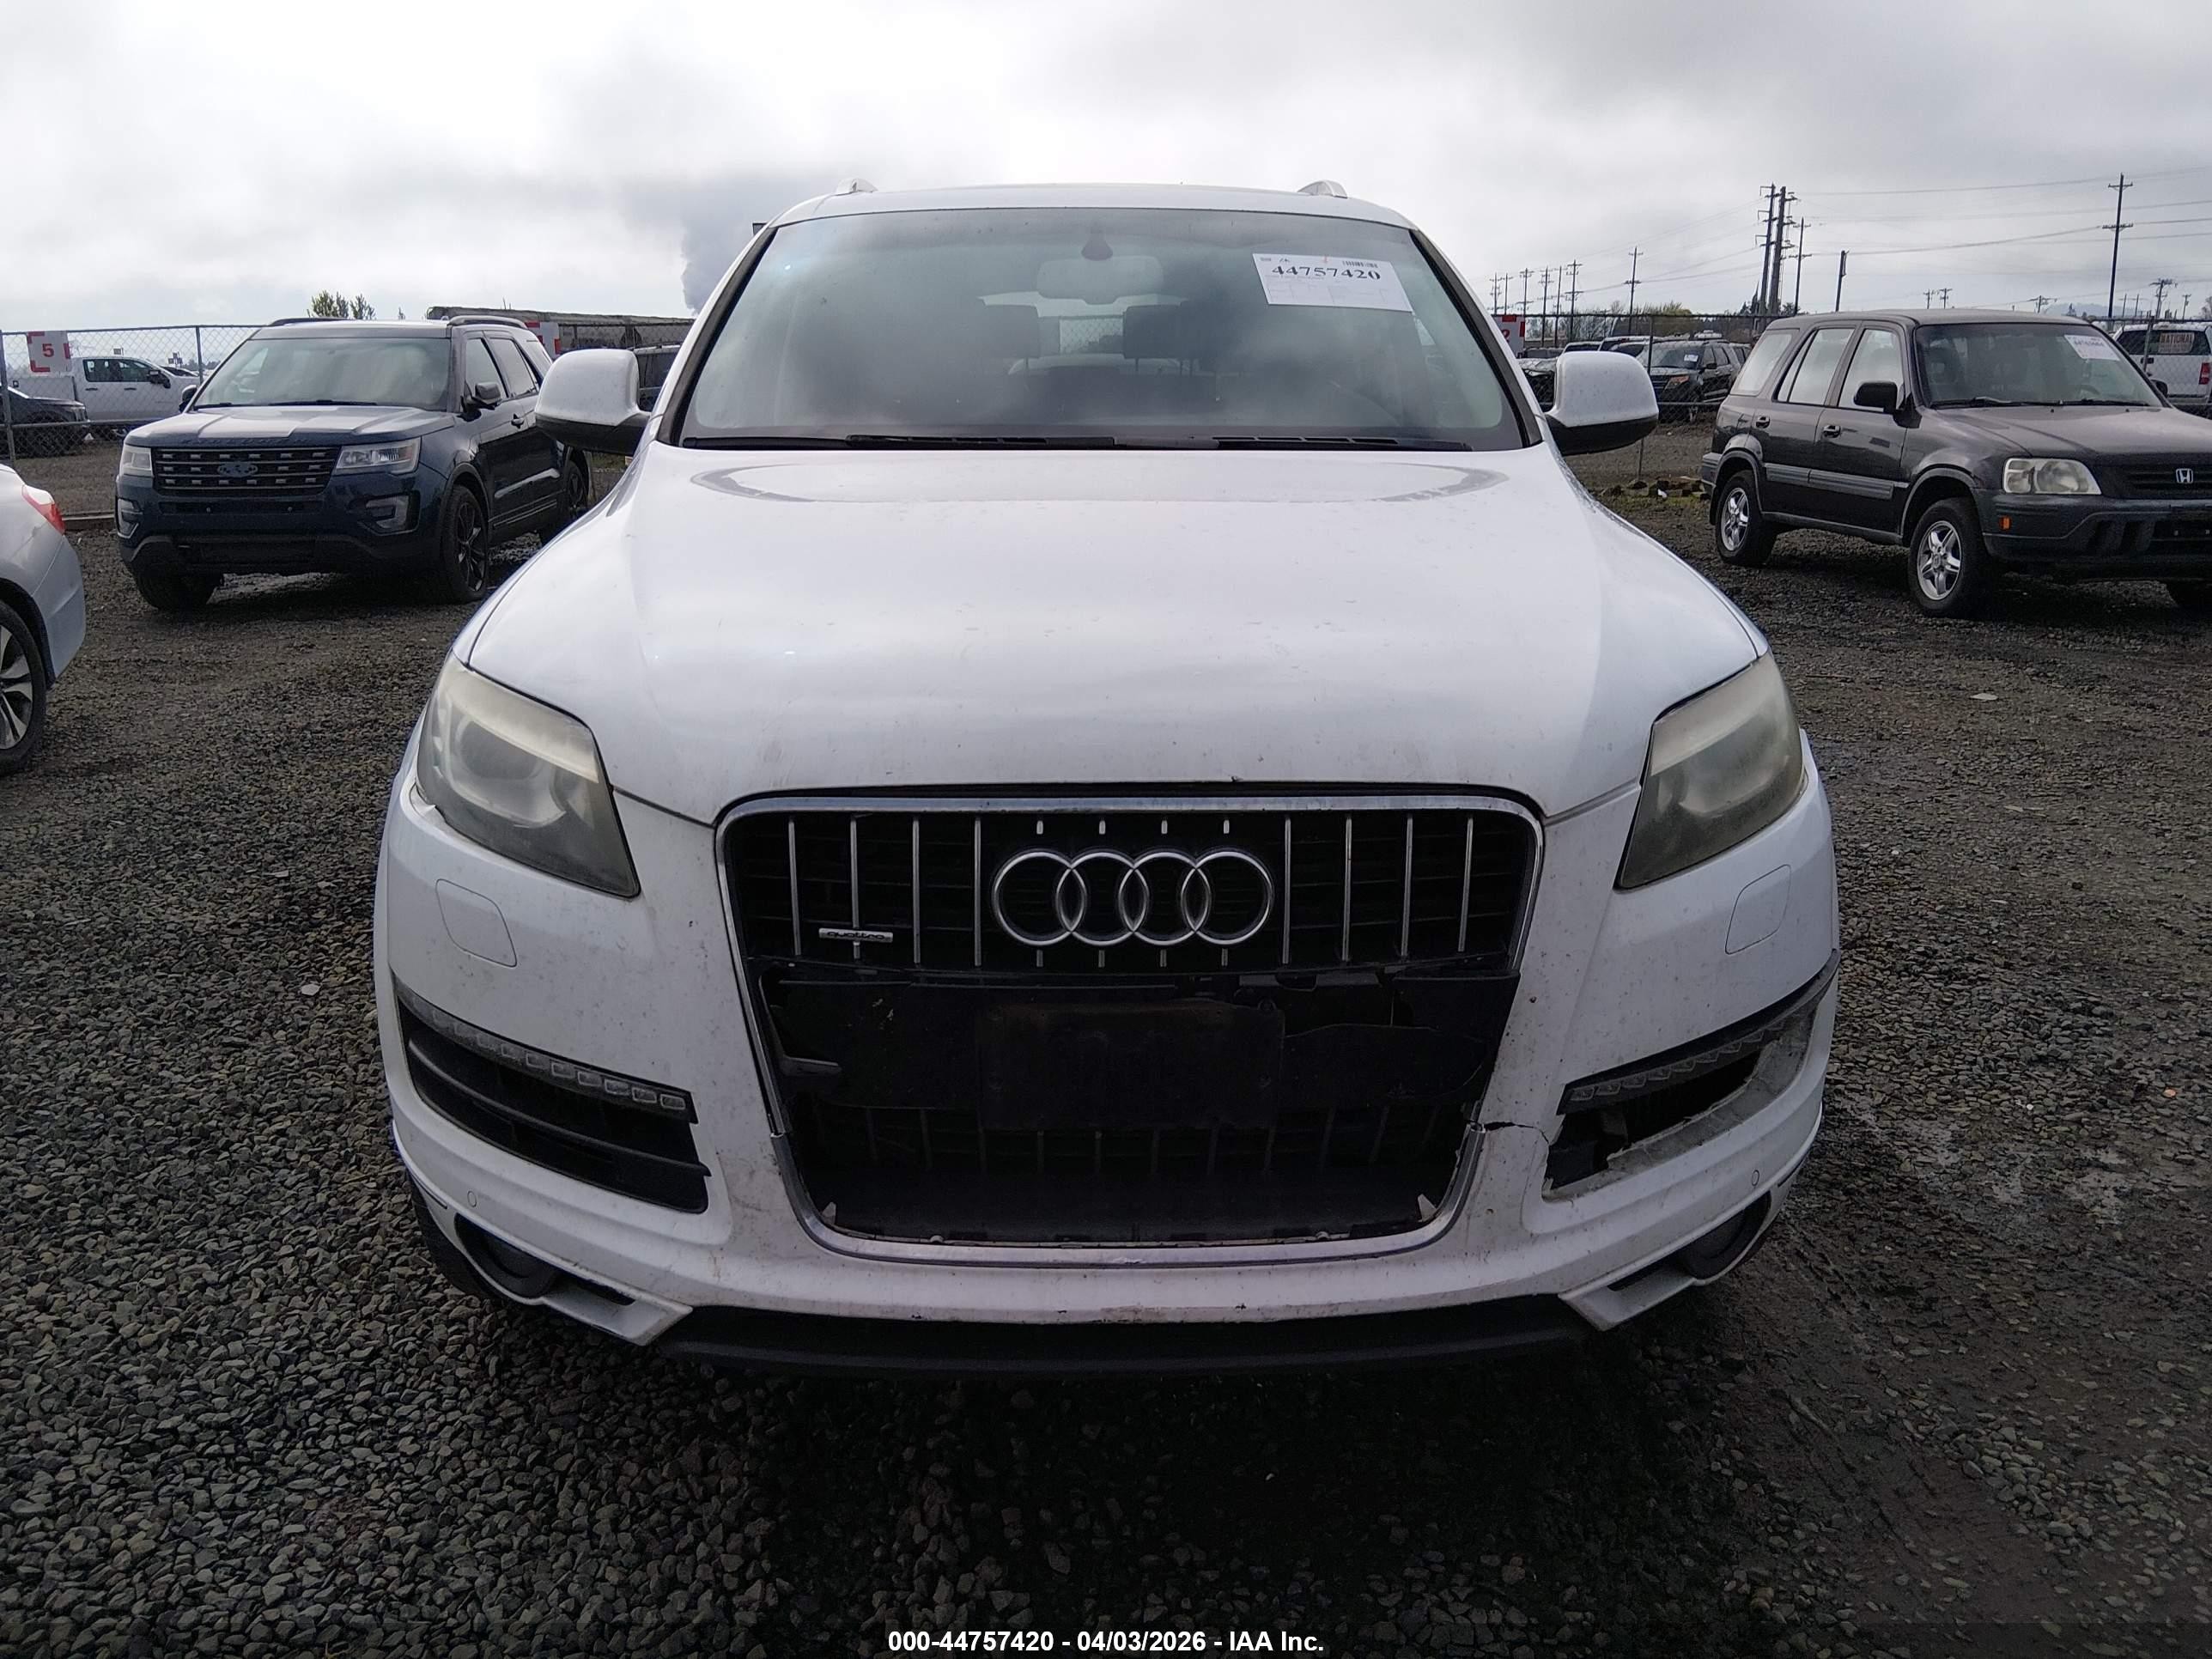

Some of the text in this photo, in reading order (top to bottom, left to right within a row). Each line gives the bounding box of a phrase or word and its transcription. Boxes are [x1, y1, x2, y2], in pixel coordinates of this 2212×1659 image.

[1272, 265, 1381, 281] 44757420
[42, 343, 54, 357] 5
[826, 931, 885, 940] quattro
